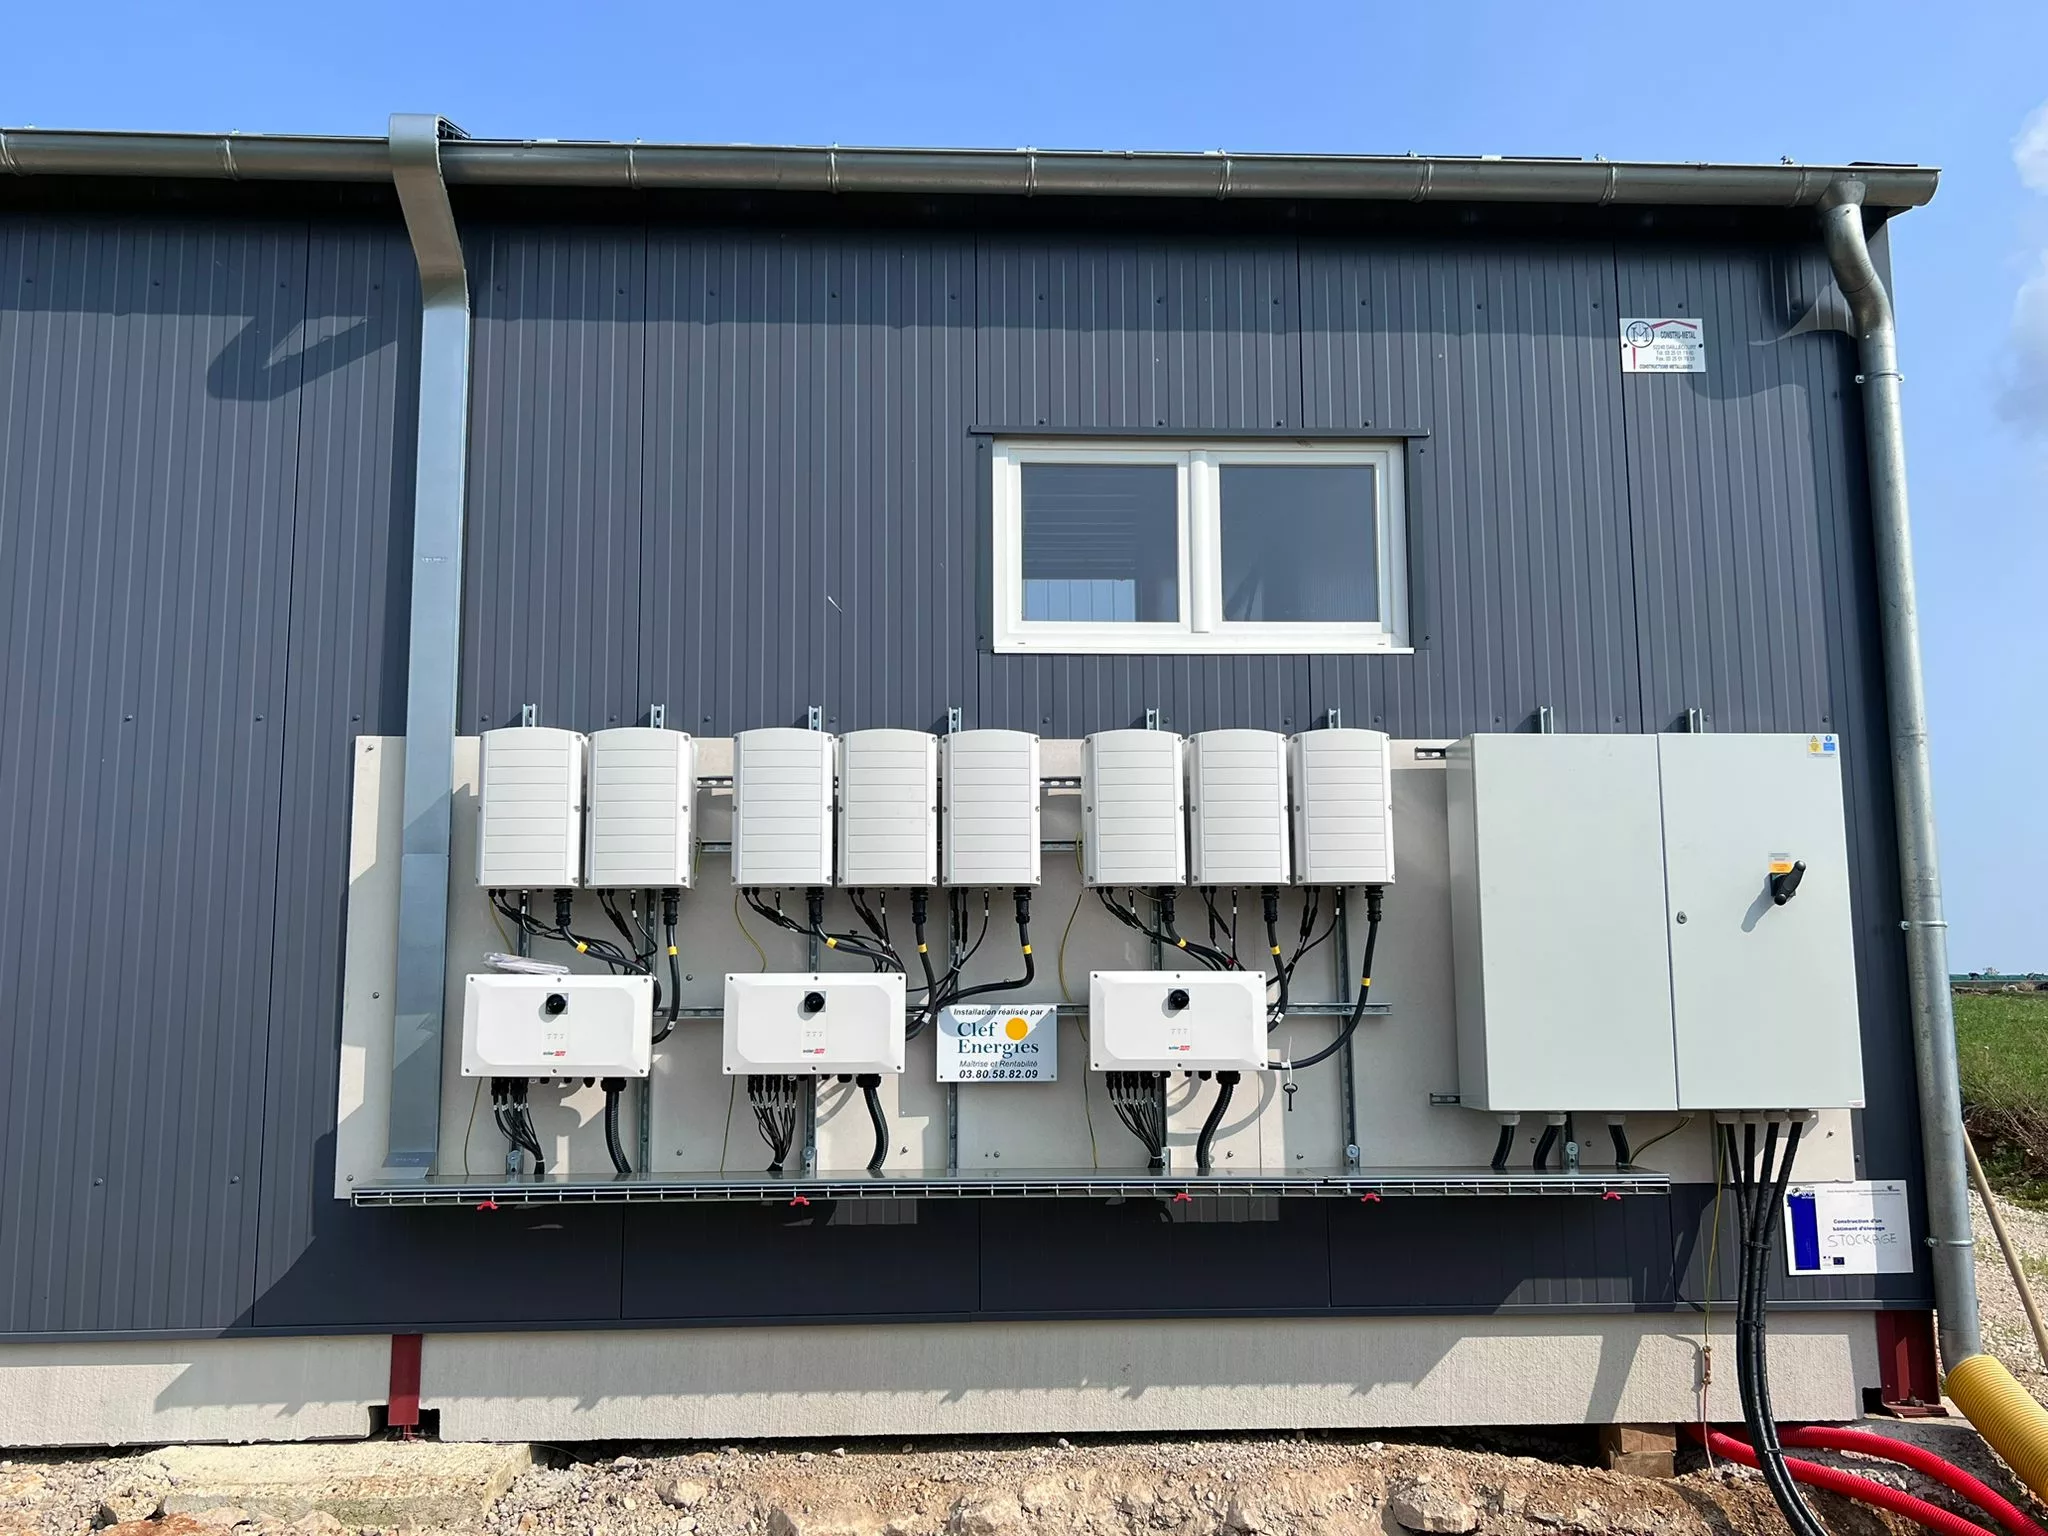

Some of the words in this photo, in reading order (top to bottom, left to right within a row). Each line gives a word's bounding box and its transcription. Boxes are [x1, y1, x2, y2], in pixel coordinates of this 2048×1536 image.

[1631, 326, 1649, 342] M
[1030, 1009, 1044, 1017] par
[957, 1021, 998, 1037] Clef
[957, 1038, 1039, 1059] Energies
[959, 1069, 1038, 1079] 03.80.58.82.09
[1827, 1232, 1897, 1248] STOCKAGE
